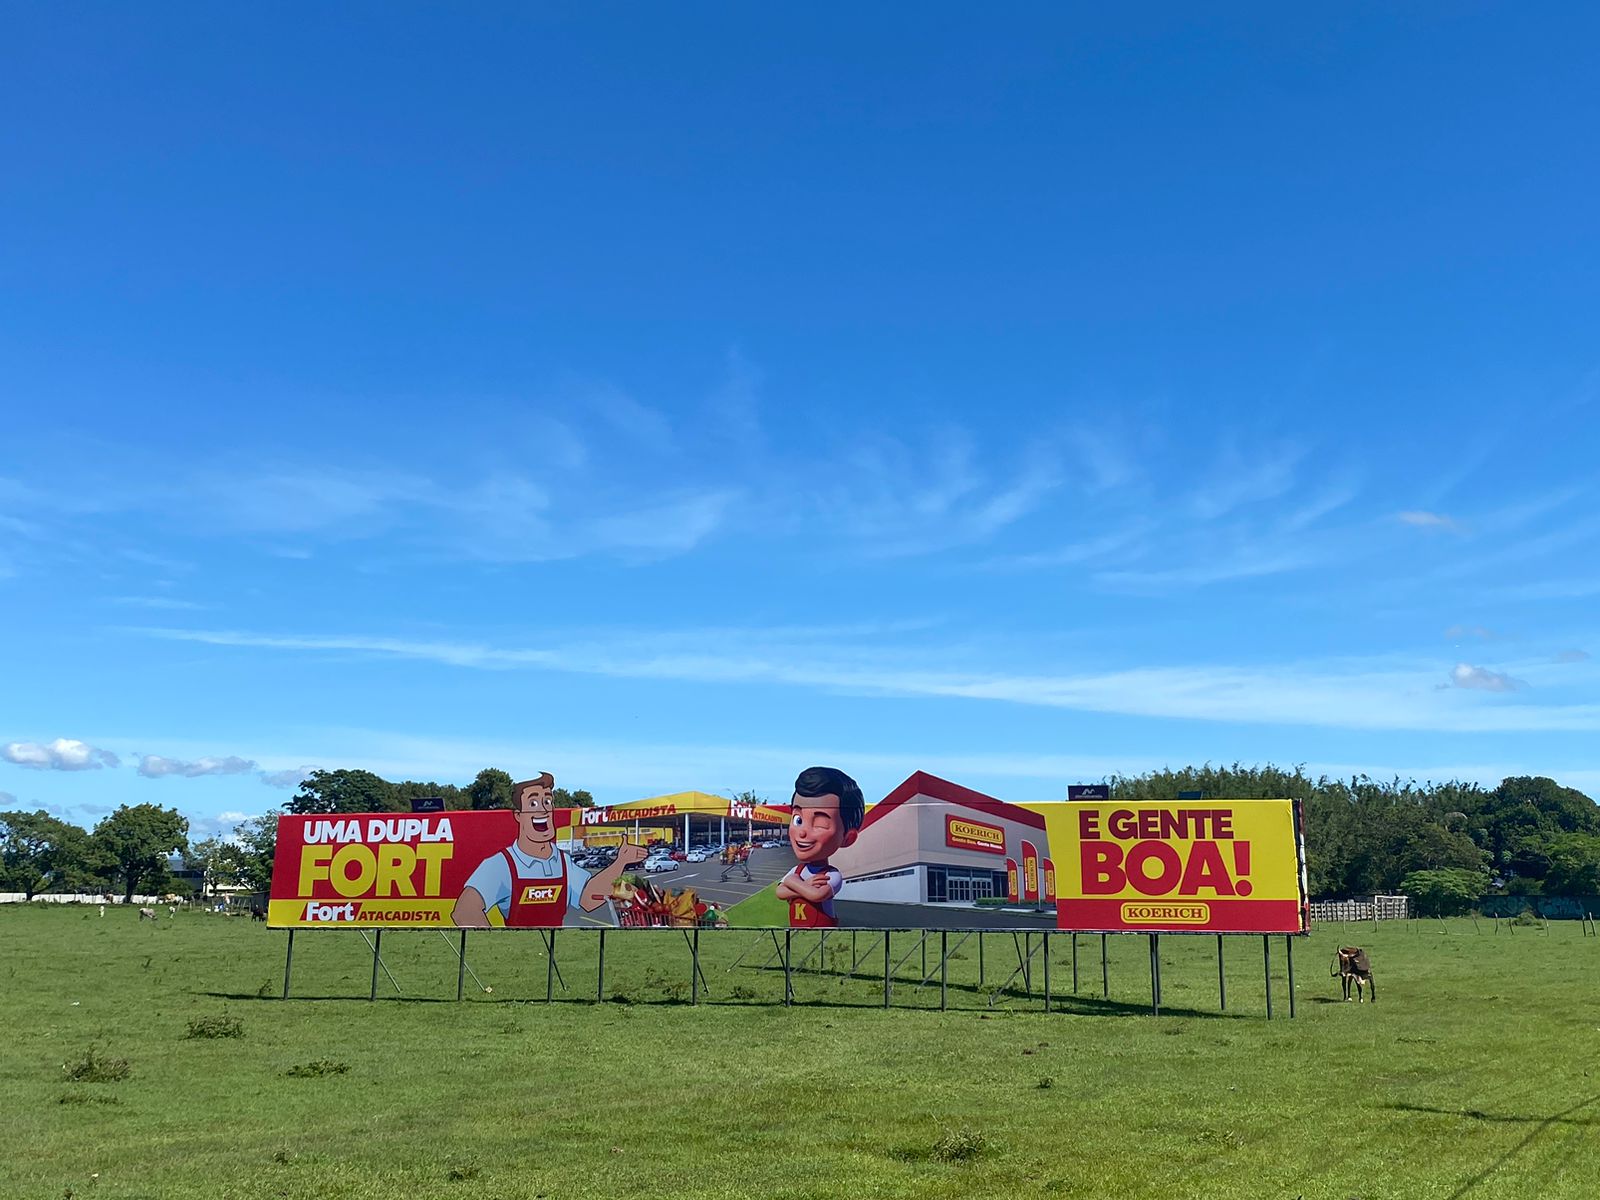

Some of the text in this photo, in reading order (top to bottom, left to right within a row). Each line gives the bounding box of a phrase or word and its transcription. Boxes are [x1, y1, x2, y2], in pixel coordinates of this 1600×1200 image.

[581, 804, 677, 825] Fort ATACADISTA
[731, 800, 753, 819] Fort
[304, 818, 454, 843] UMA DUPLA
[955, 824, 1000, 840] KOERICH
[1079, 809, 1234, 840] E GENTE
[298, 843, 454, 898] FORT
[1080, 840, 1253, 897] BOA!
[528, 888, 553, 899] Fort
[306, 902, 441, 921] Fort ATACADISTA
[795, 903, 807, 920] K
[1127, 908, 1203, 919] KOERICH
